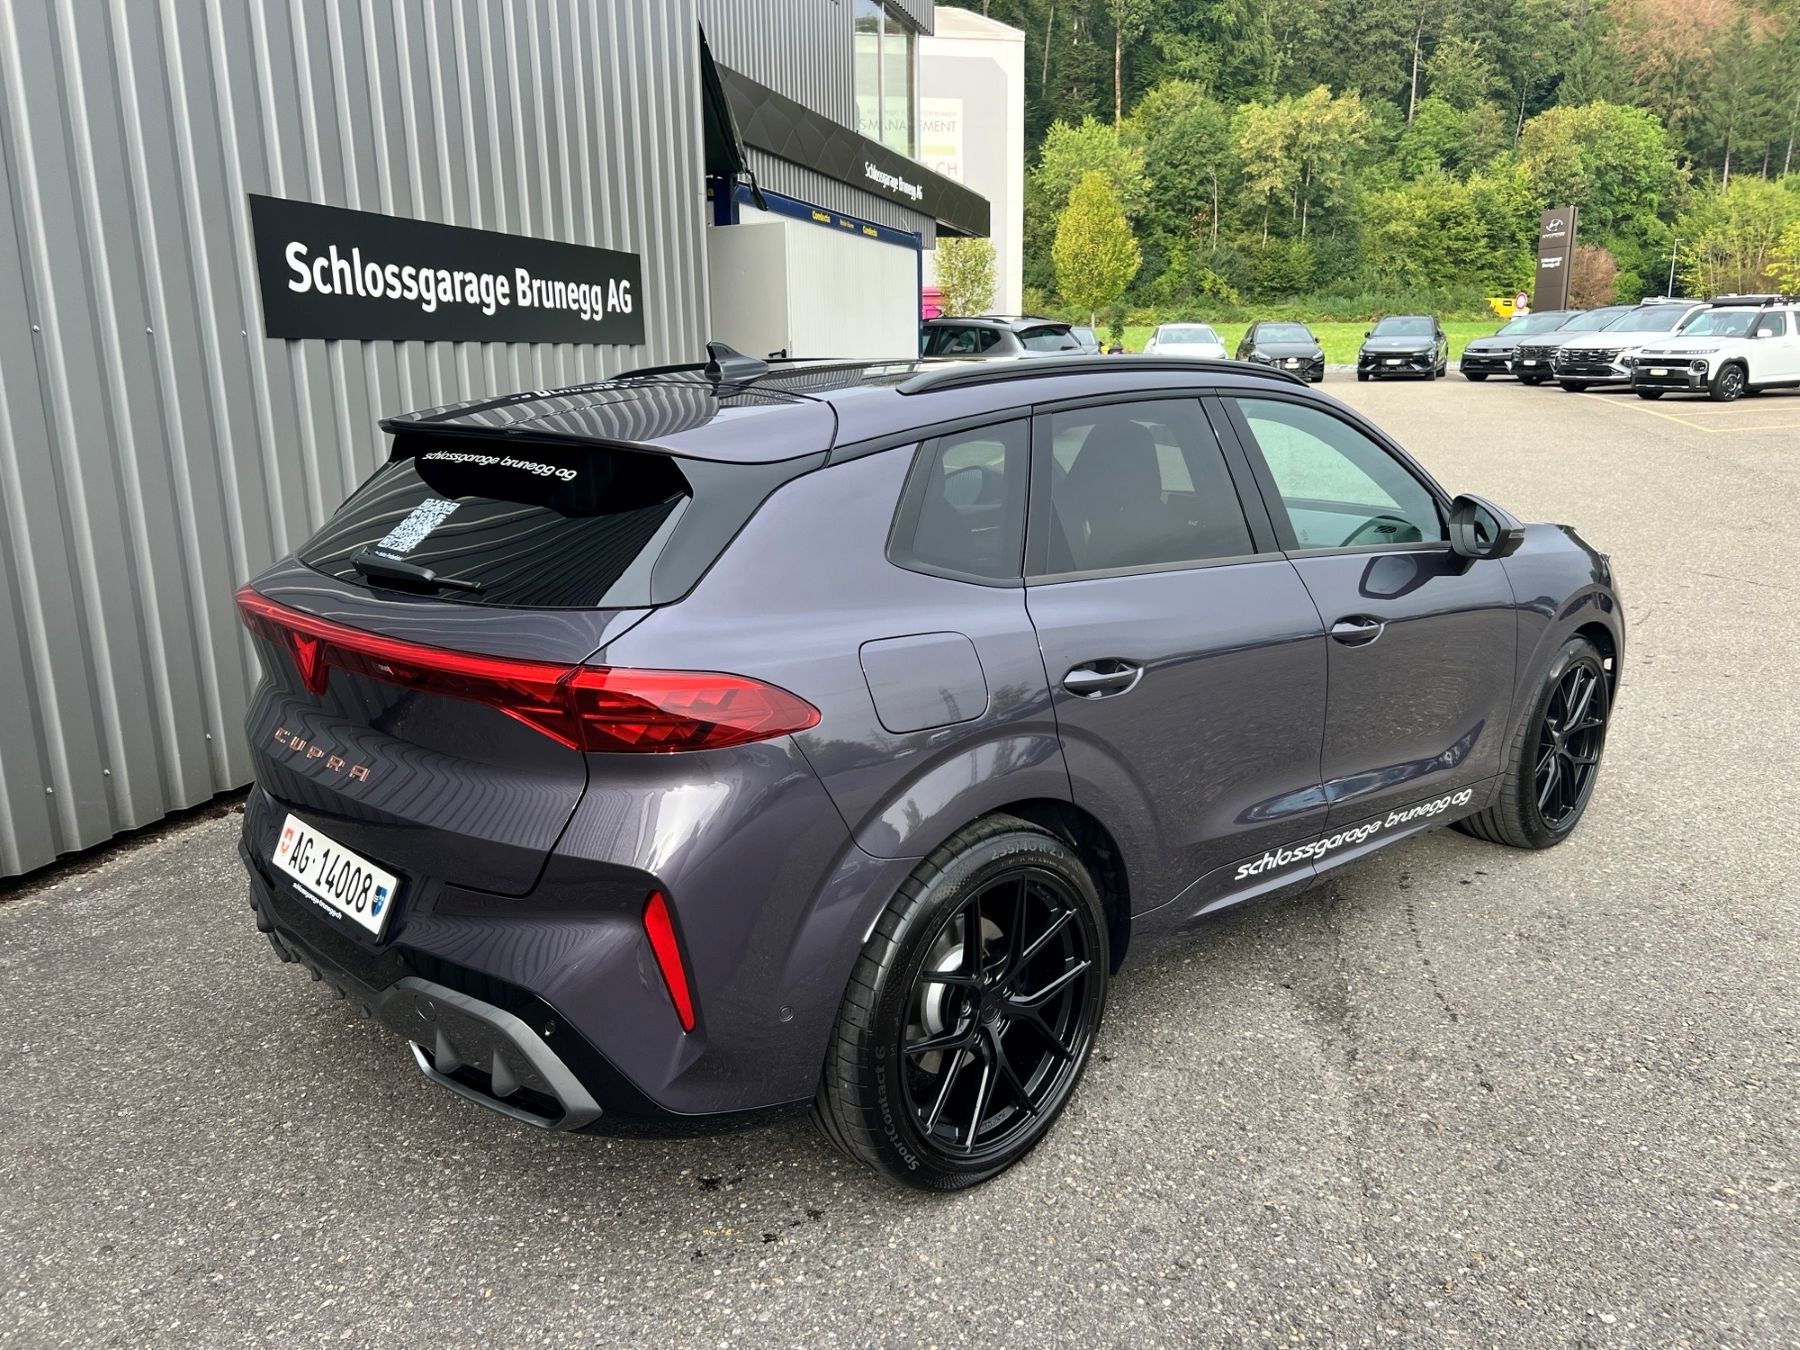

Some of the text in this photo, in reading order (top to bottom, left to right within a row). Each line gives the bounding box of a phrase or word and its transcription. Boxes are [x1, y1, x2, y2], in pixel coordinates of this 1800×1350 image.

[285, 241, 632, 321] Schlossgarage Brunegg AG
[422, 450, 577, 481] schlossgarage brunegg ag
[274, 727, 371, 783] CUPRA
[1235, 788, 1472, 880] schlossgarage brunegg ag
